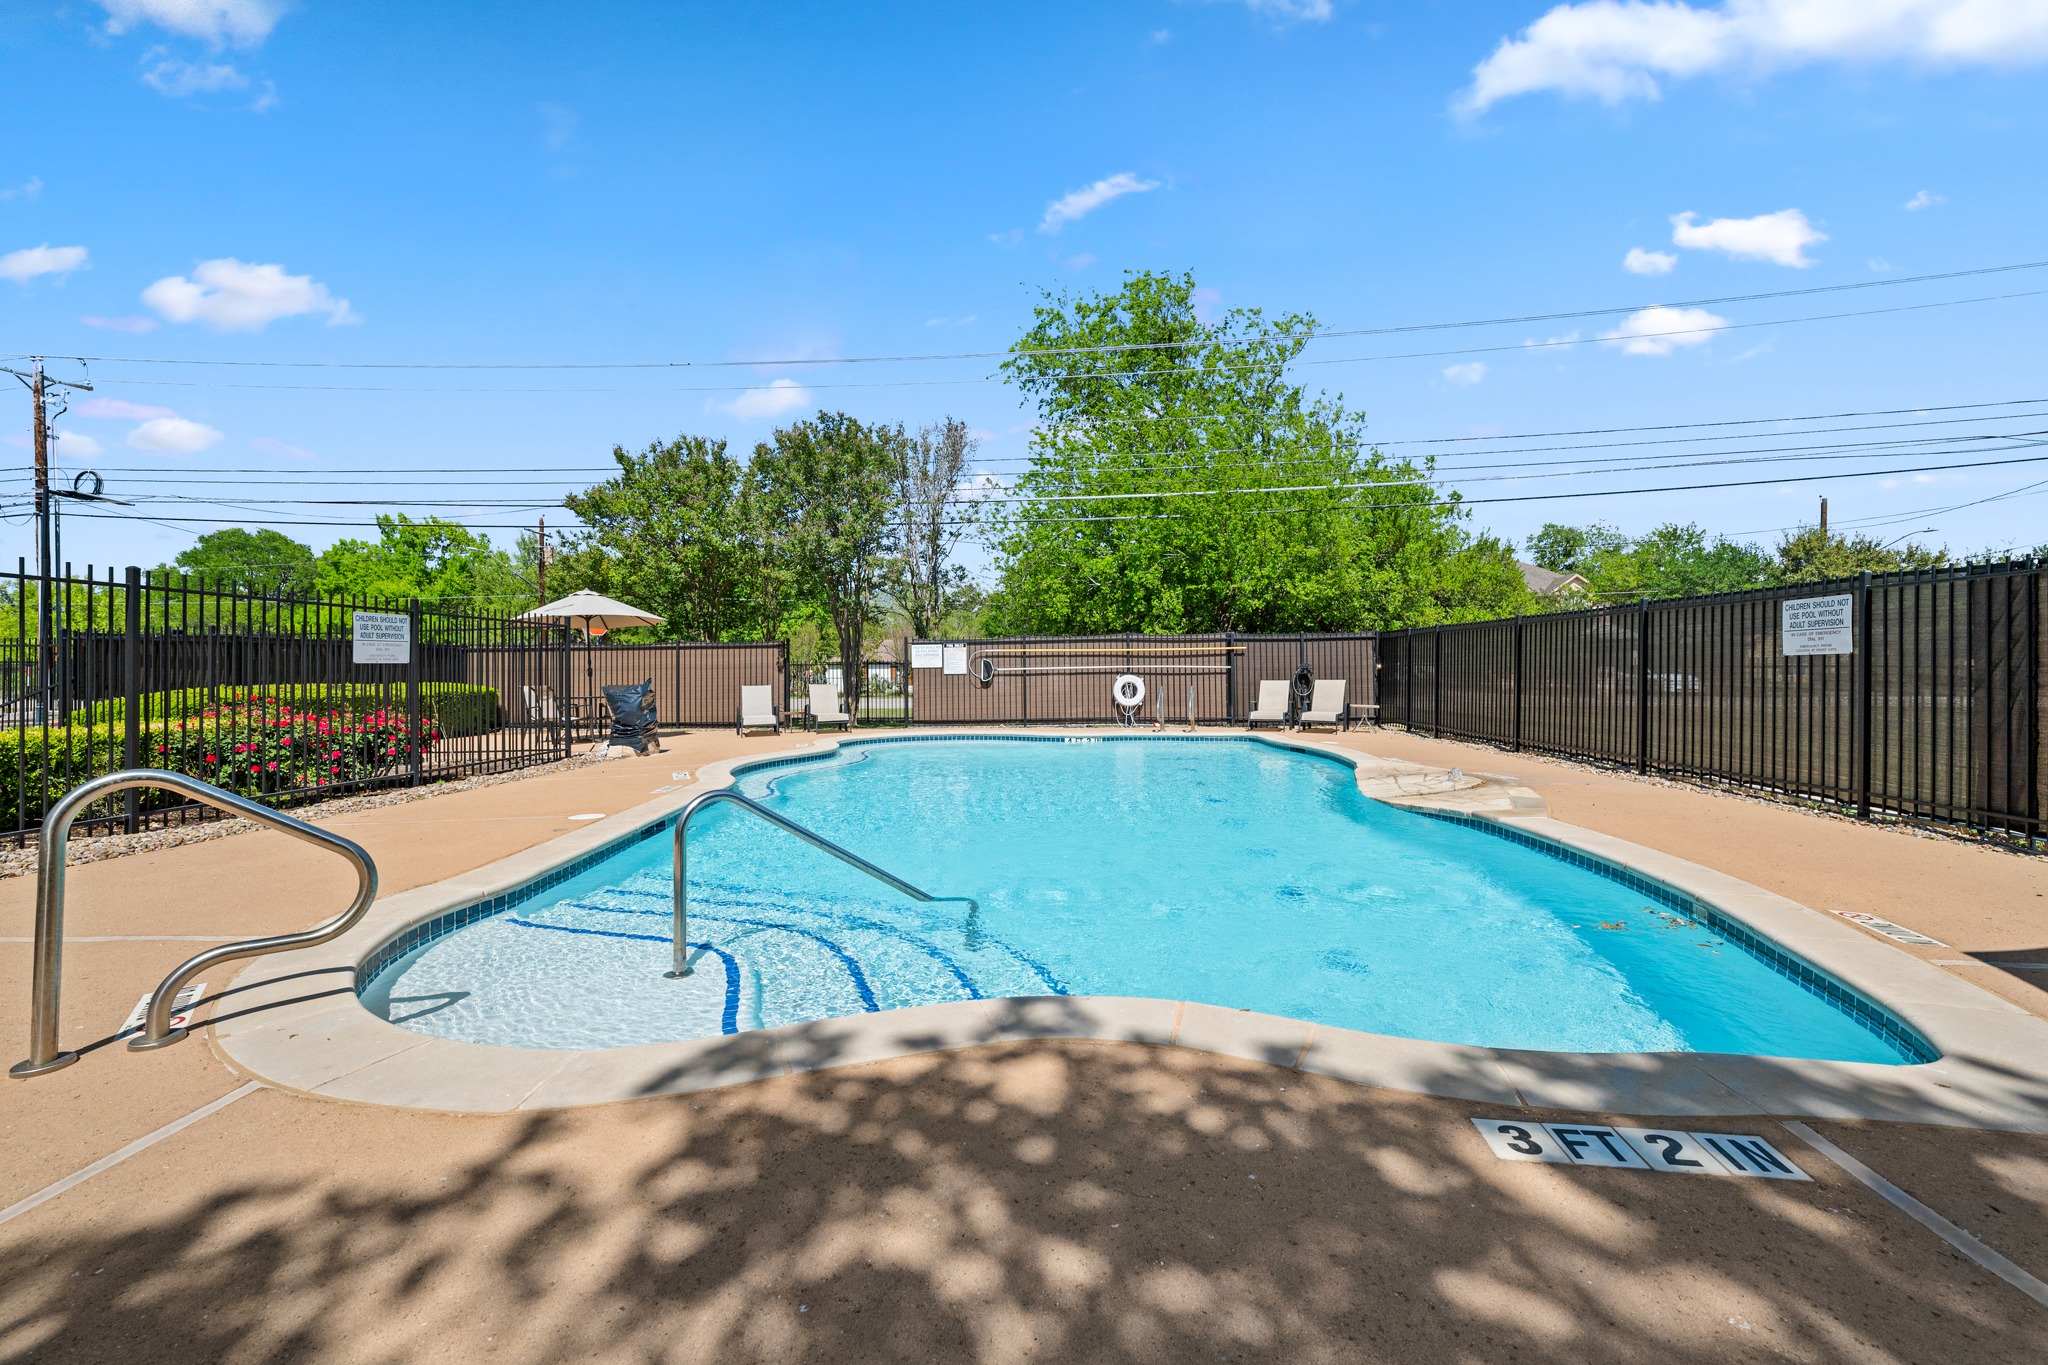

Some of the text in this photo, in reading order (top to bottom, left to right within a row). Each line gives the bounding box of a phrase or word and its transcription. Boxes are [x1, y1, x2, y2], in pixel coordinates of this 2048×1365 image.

[1785, 603, 1810, 611] CHILDREN
[1812, 600, 1835, 609] SHOULD
[1789, 609, 1843, 620] USE POOL WITHOUT
[1789, 618, 1844, 629] ADULT SUPERVISION
[1497, 1125, 1794, 1173] 3 FT 2 IN
